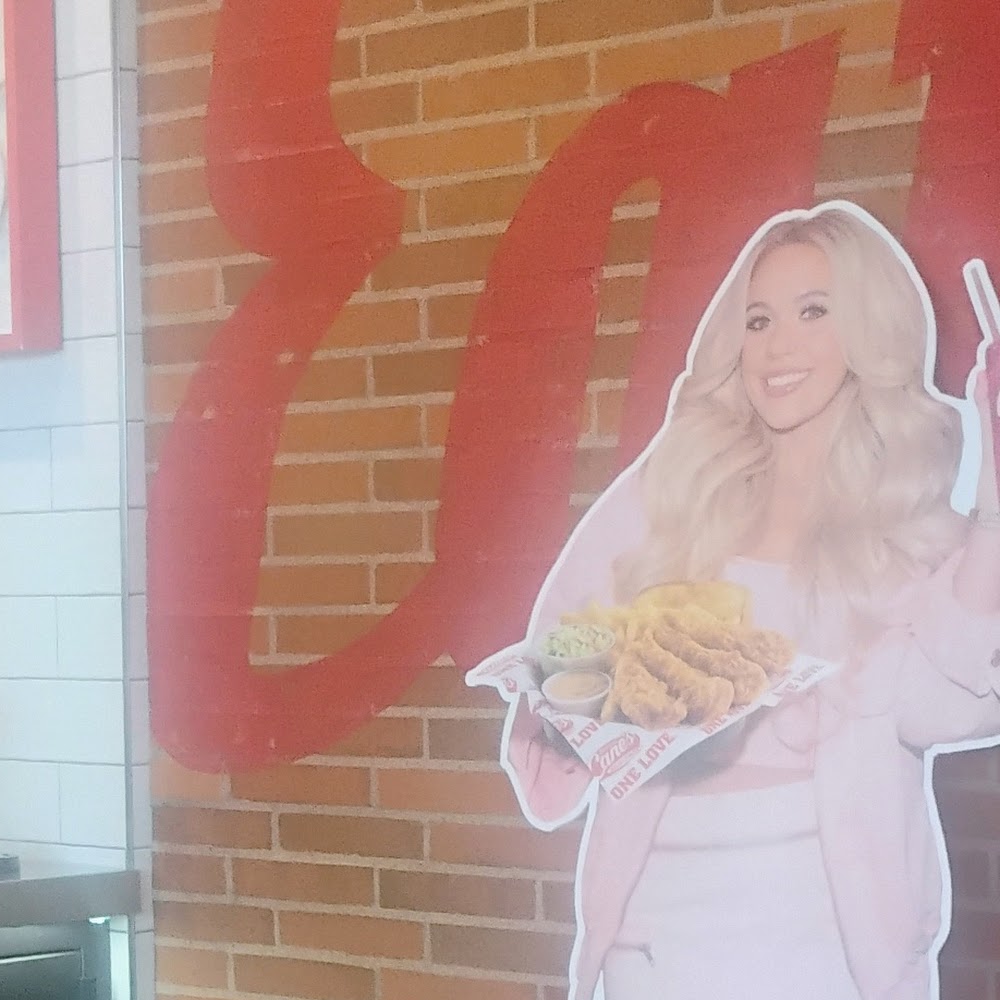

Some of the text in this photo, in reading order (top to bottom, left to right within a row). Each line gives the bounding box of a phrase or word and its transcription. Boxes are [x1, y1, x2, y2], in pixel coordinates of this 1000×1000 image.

[570, 720, 600, 748] LOV
[610, 730, 676, 800] ONE LOVE
